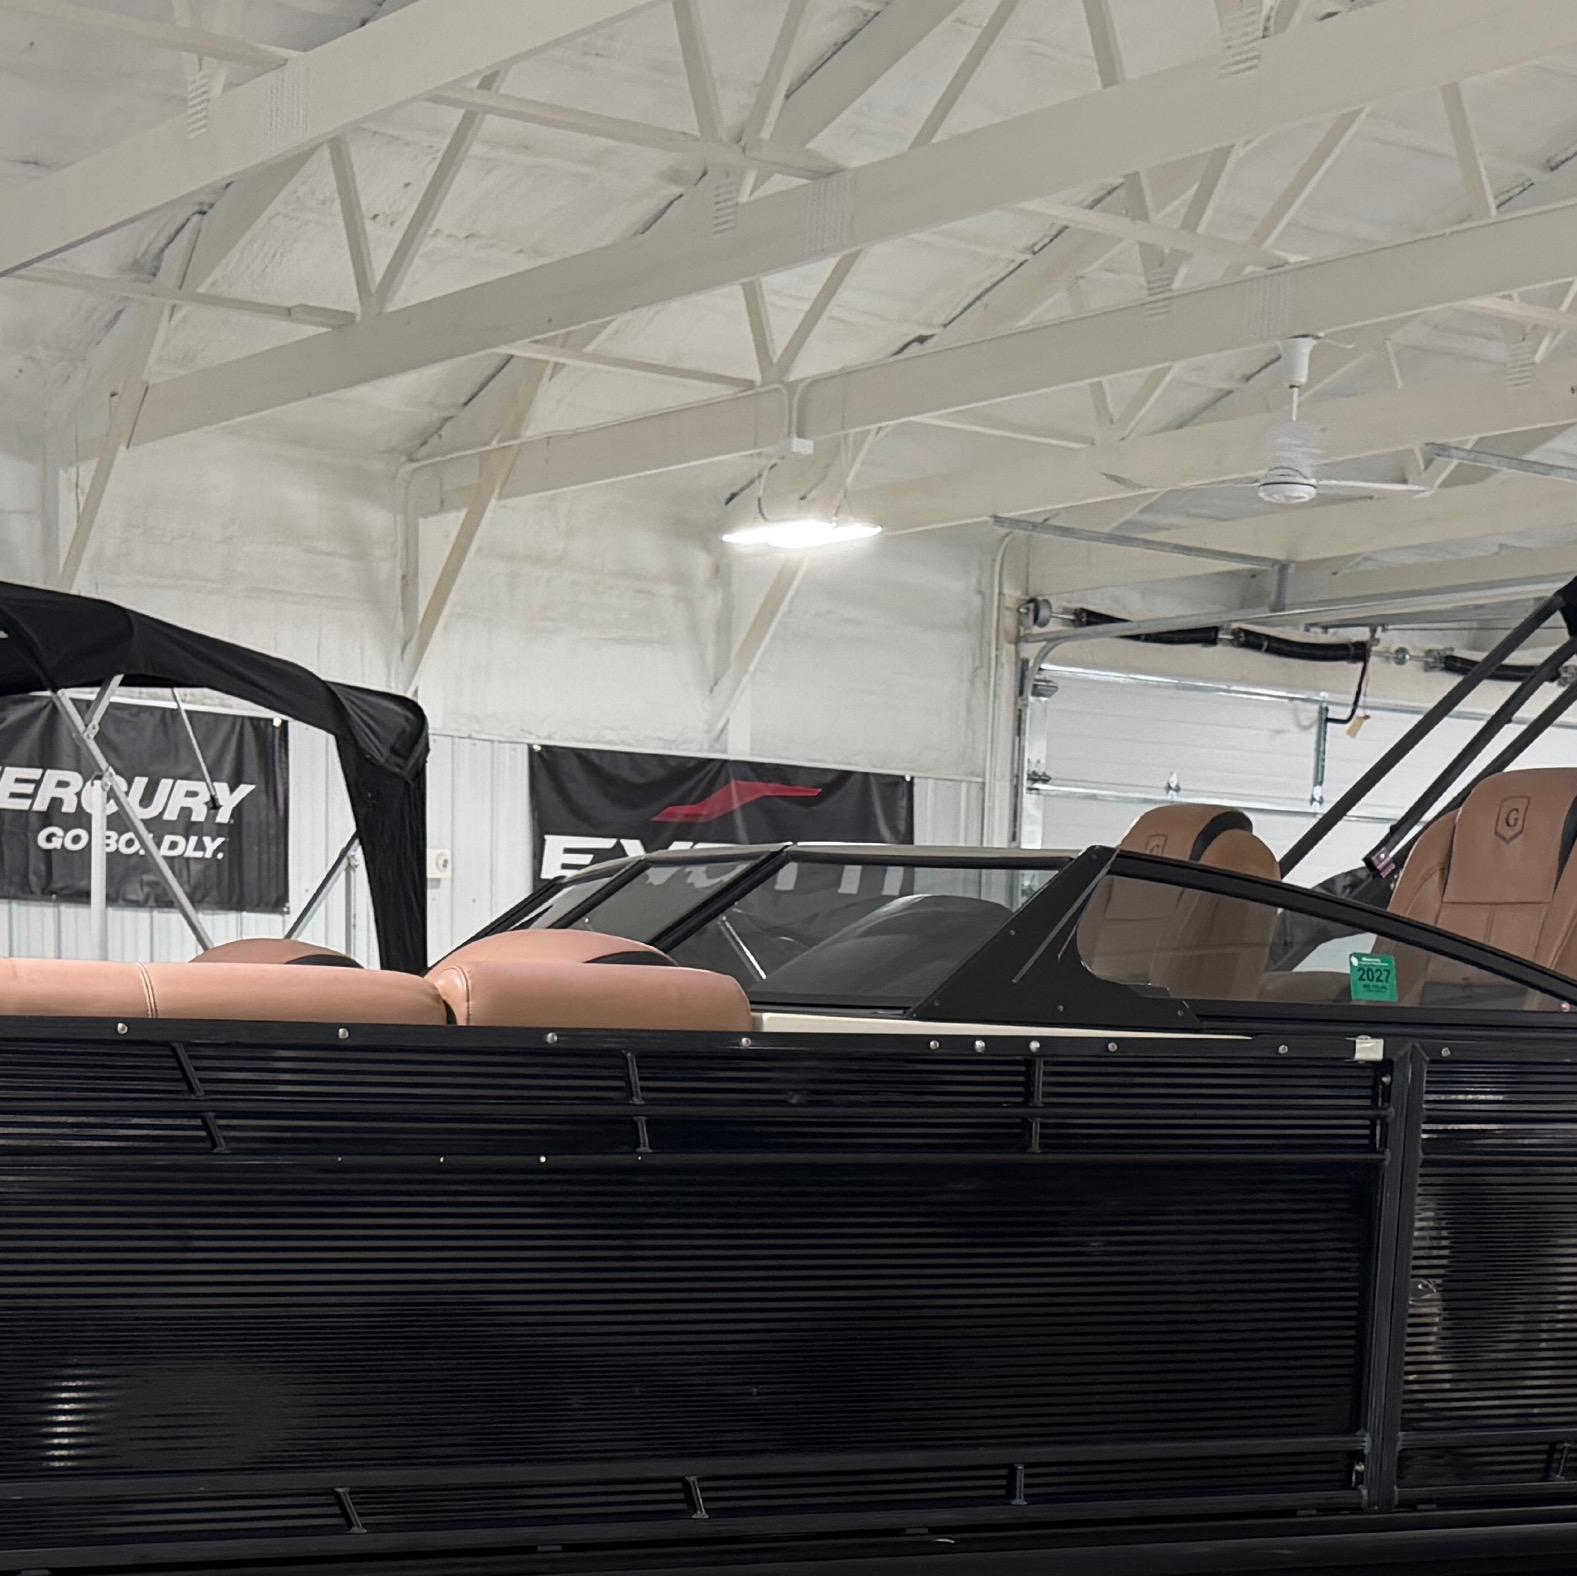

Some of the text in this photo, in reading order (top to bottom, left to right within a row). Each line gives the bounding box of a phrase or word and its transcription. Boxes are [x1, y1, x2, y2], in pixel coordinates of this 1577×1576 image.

[37, 825, 225, 860] GO BODLY.
[1357, 967, 1391, 983] 2027
